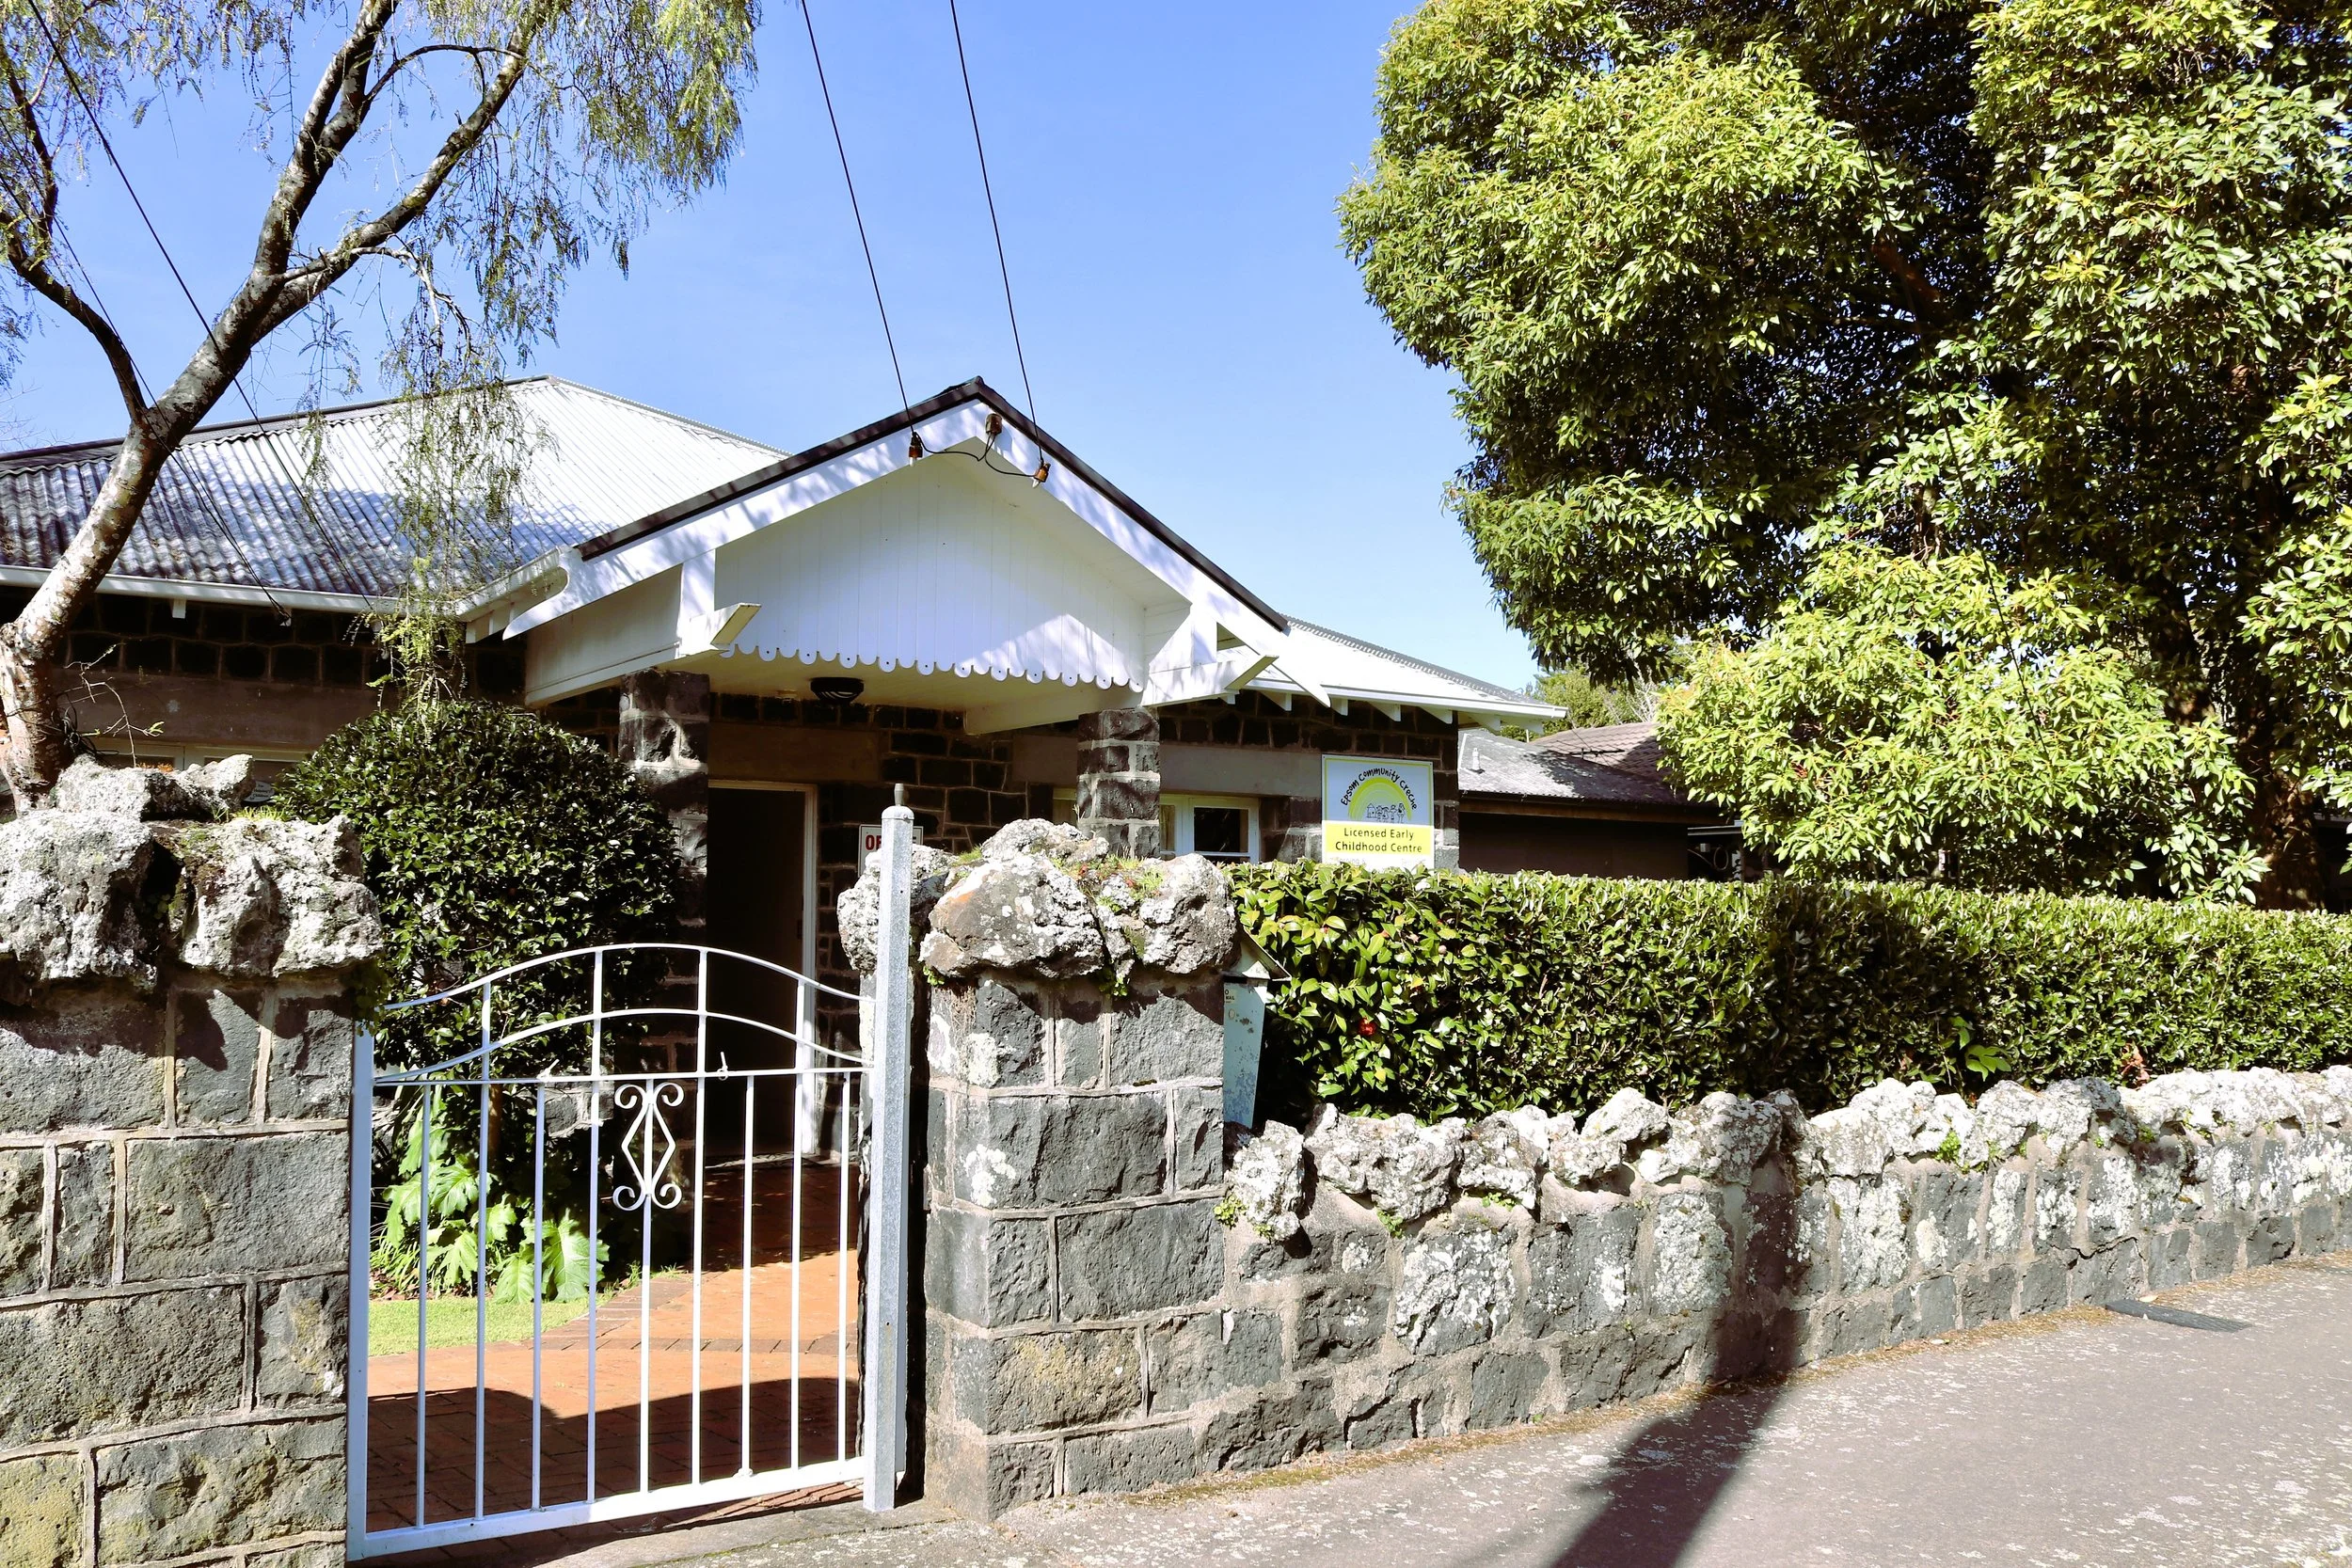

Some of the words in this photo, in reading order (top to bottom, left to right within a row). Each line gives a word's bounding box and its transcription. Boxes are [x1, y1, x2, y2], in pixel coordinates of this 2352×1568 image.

[1341, 780, 1359, 806] Epsom
[1359, 768, 1400, 783] Community
[1399, 780, 1418, 810] Creche
[1343, 828, 1387, 838] Licensed
[1390, 830, 1414, 841] Early
[1335, 841, 1387, 851] Childhood
[1391, 843, 1422, 853] Centre
